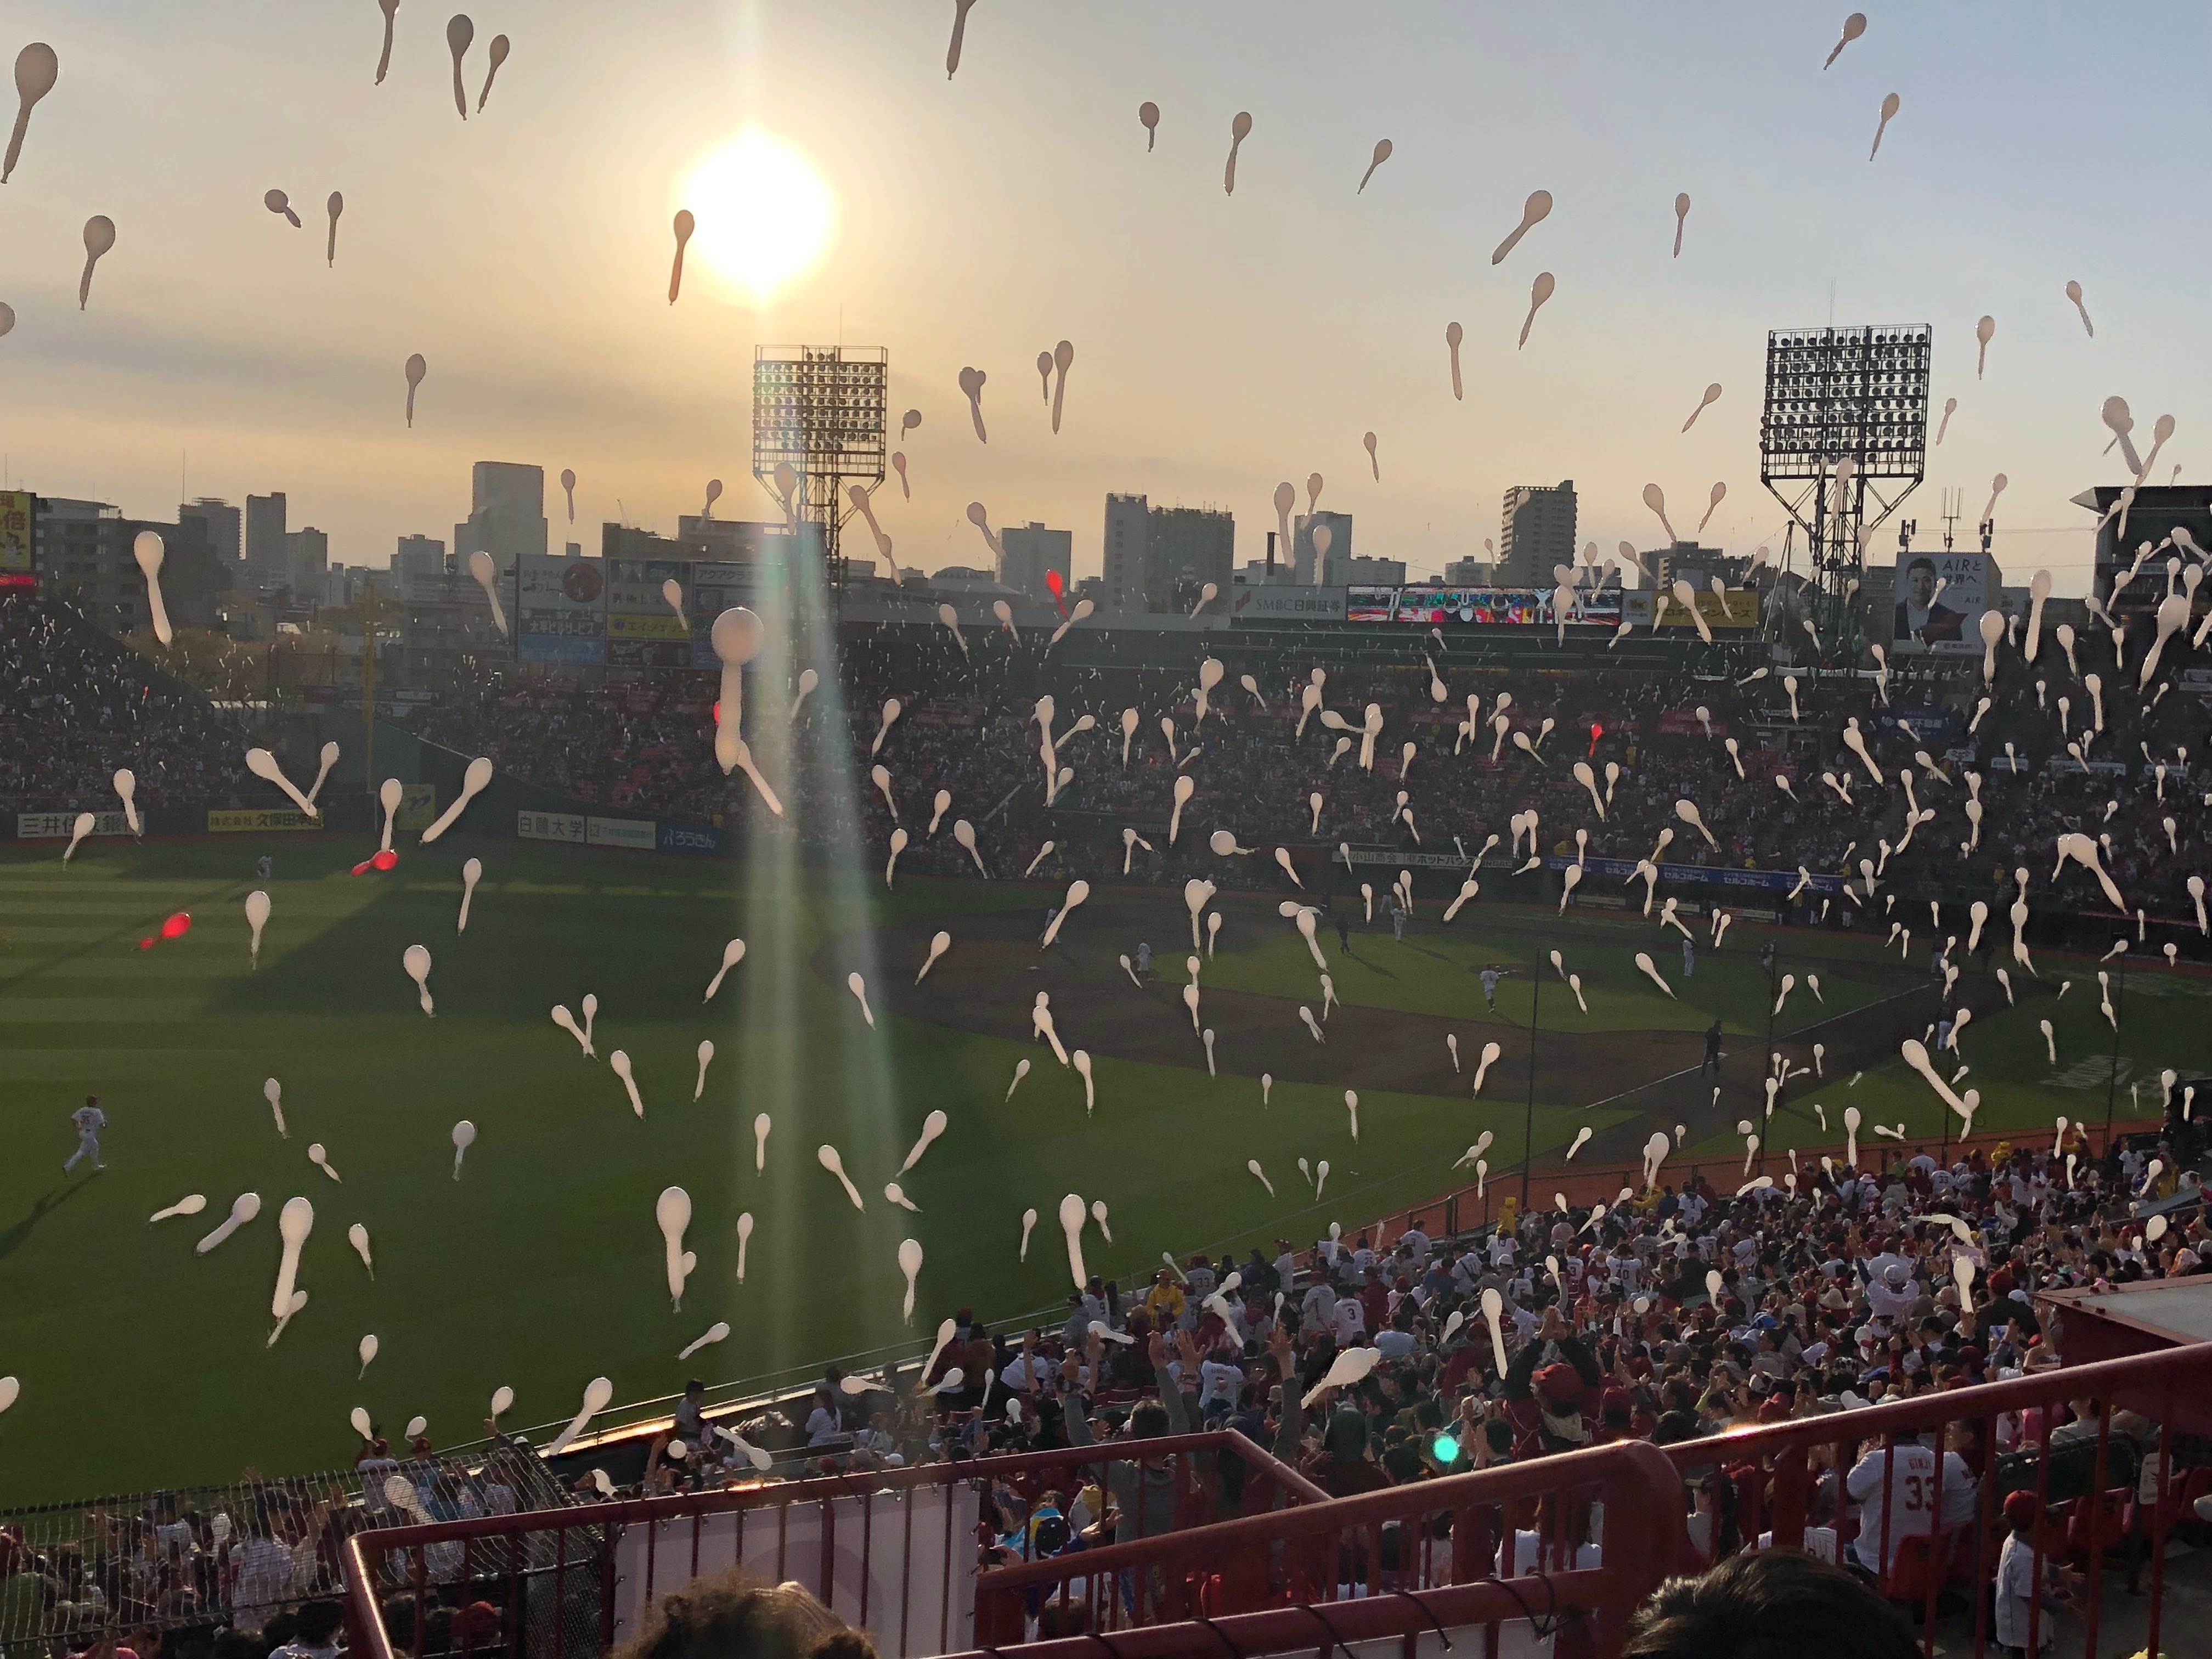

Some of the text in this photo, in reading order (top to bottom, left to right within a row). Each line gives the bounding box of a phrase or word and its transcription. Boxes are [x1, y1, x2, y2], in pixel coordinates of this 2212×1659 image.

[1942, 559, 1982, 571] AIRと
[1256, 599, 1341, 612] SMBC日興証券
[675, 831, 715, 849] ろうきん
[1417, 855, 1474, 865] ホットハウス
[1663, 872, 1709, 882] セルコホーム
[1723, 877, 1769, 887] セルコホーム
[1197, 1277, 1209, 1288] 33
[1347, 1308, 1355, 1320] 3
